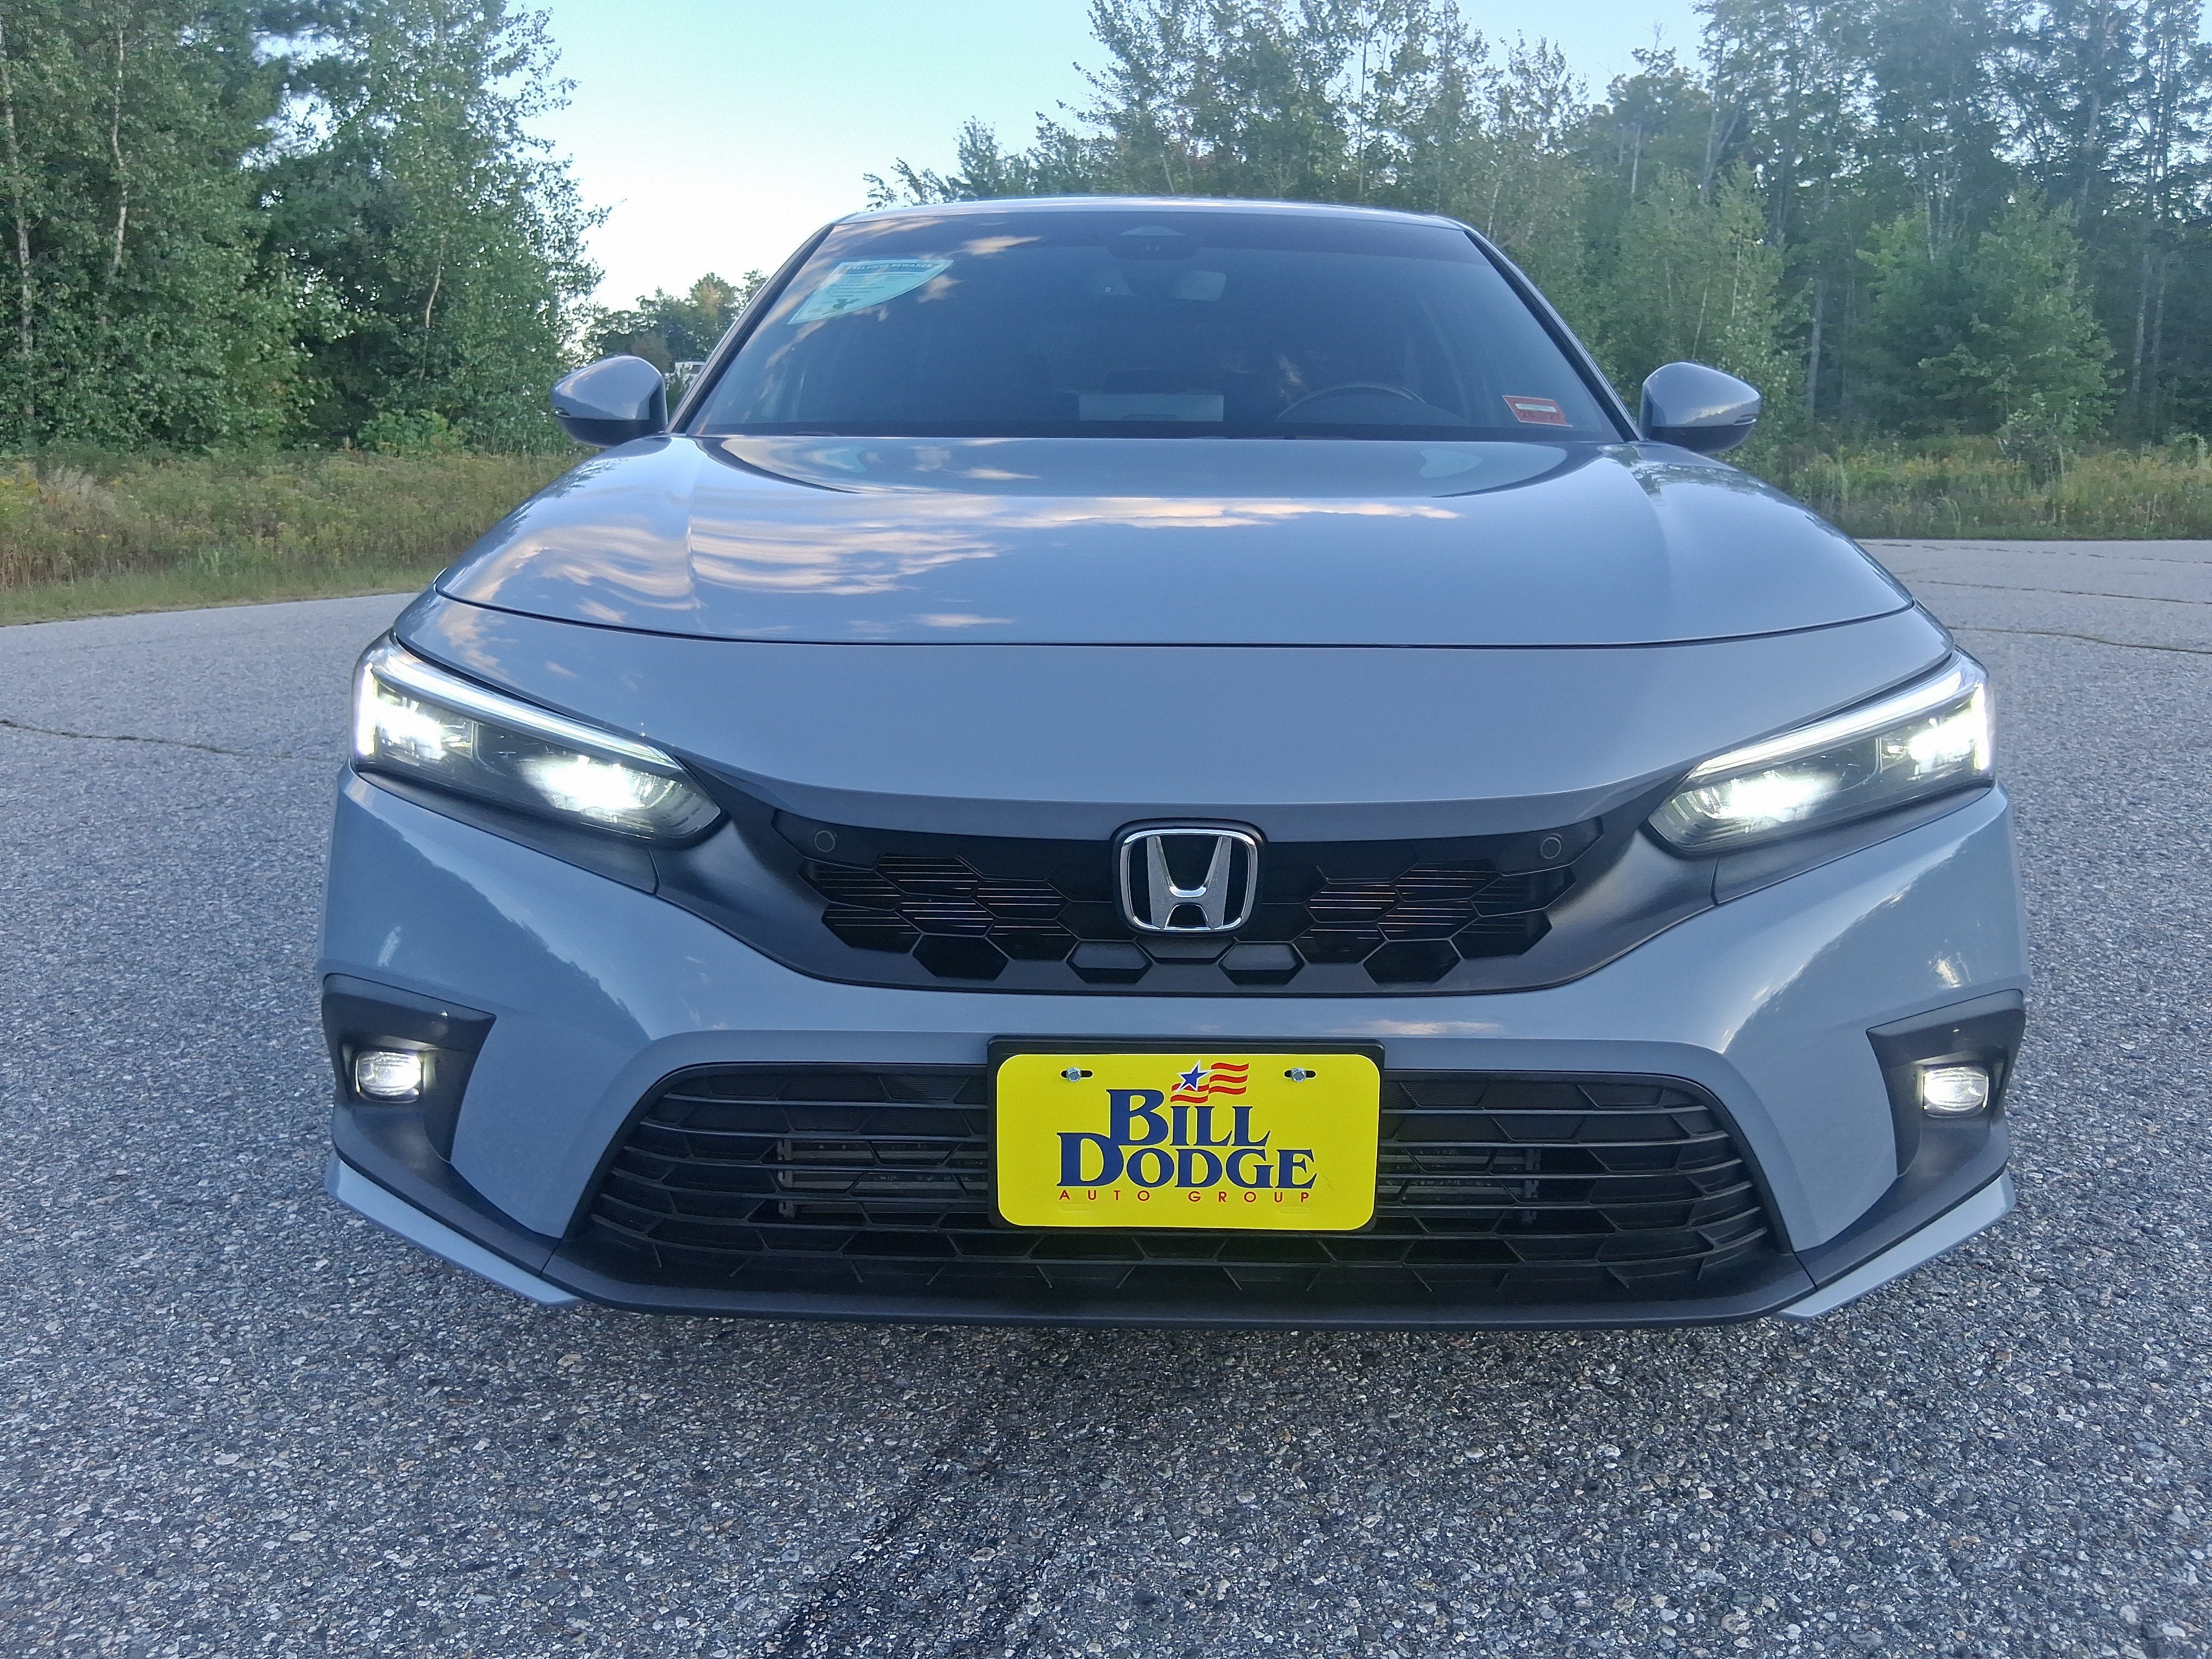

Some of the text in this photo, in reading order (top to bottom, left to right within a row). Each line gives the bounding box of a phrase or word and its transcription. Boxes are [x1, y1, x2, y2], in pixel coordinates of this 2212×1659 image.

[1106, 1089, 1271, 1147] BILL
[1056, 1132, 1317, 1189] DODGE
[1059, 1189, 1310, 1203] AUTO GROUP
